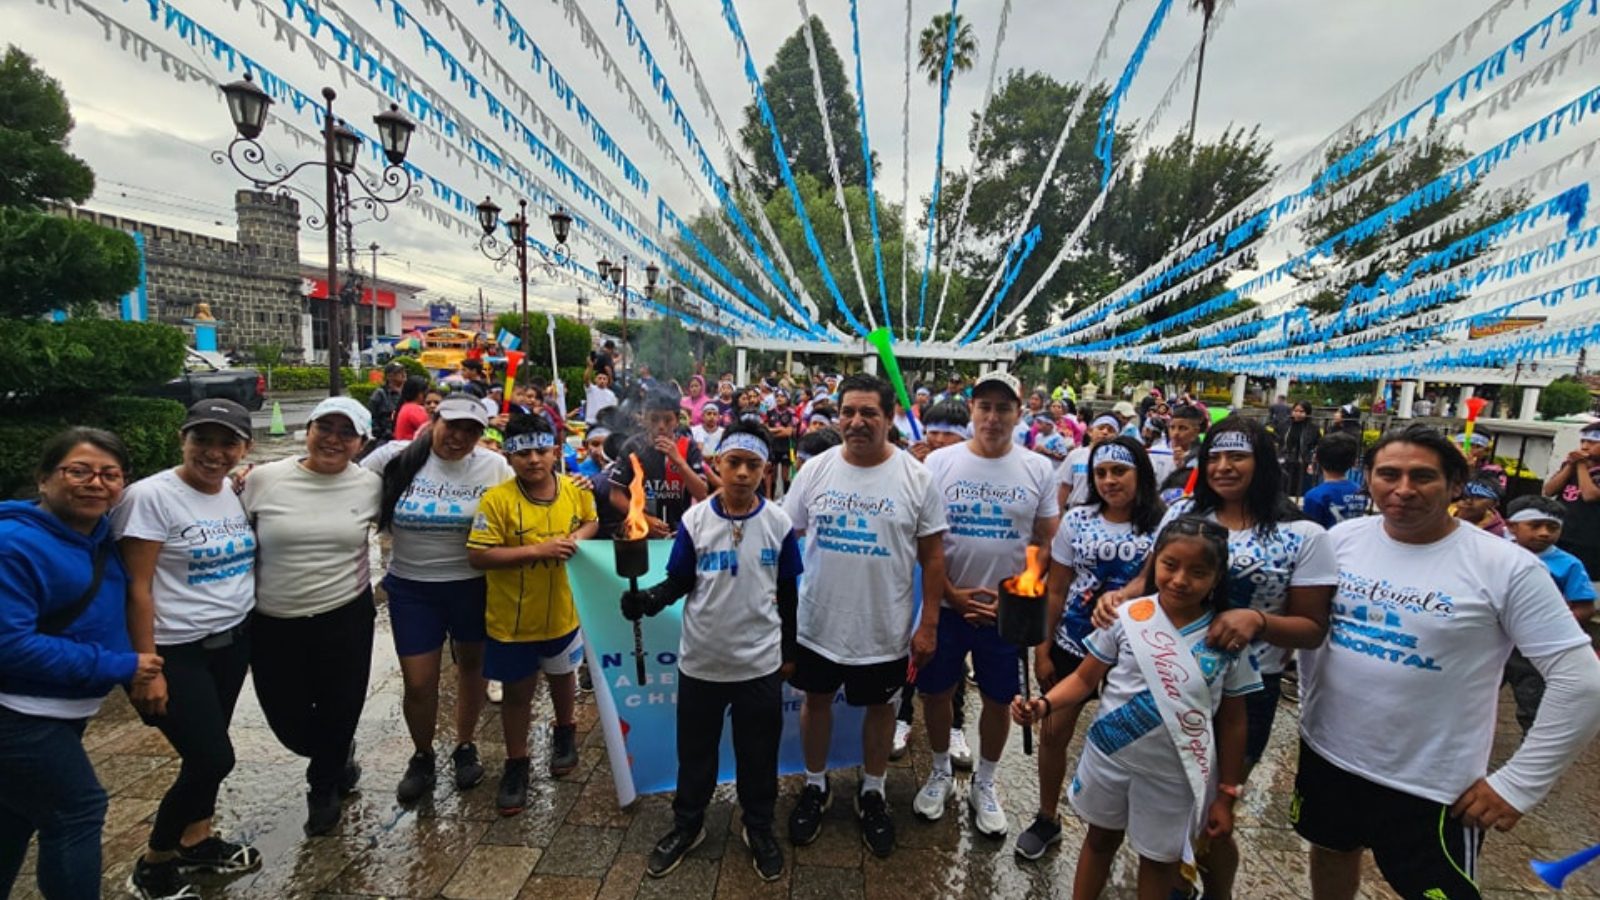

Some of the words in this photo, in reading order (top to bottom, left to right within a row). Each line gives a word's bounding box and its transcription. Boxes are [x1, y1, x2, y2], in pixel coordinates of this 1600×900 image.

[645, 481, 681, 491] ATAR
[947, 504, 967, 513] TU
[816, 515, 833, 524] TU
[190, 546, 221, 559] TU
[1337, 580, 1453, 614] uatemala
